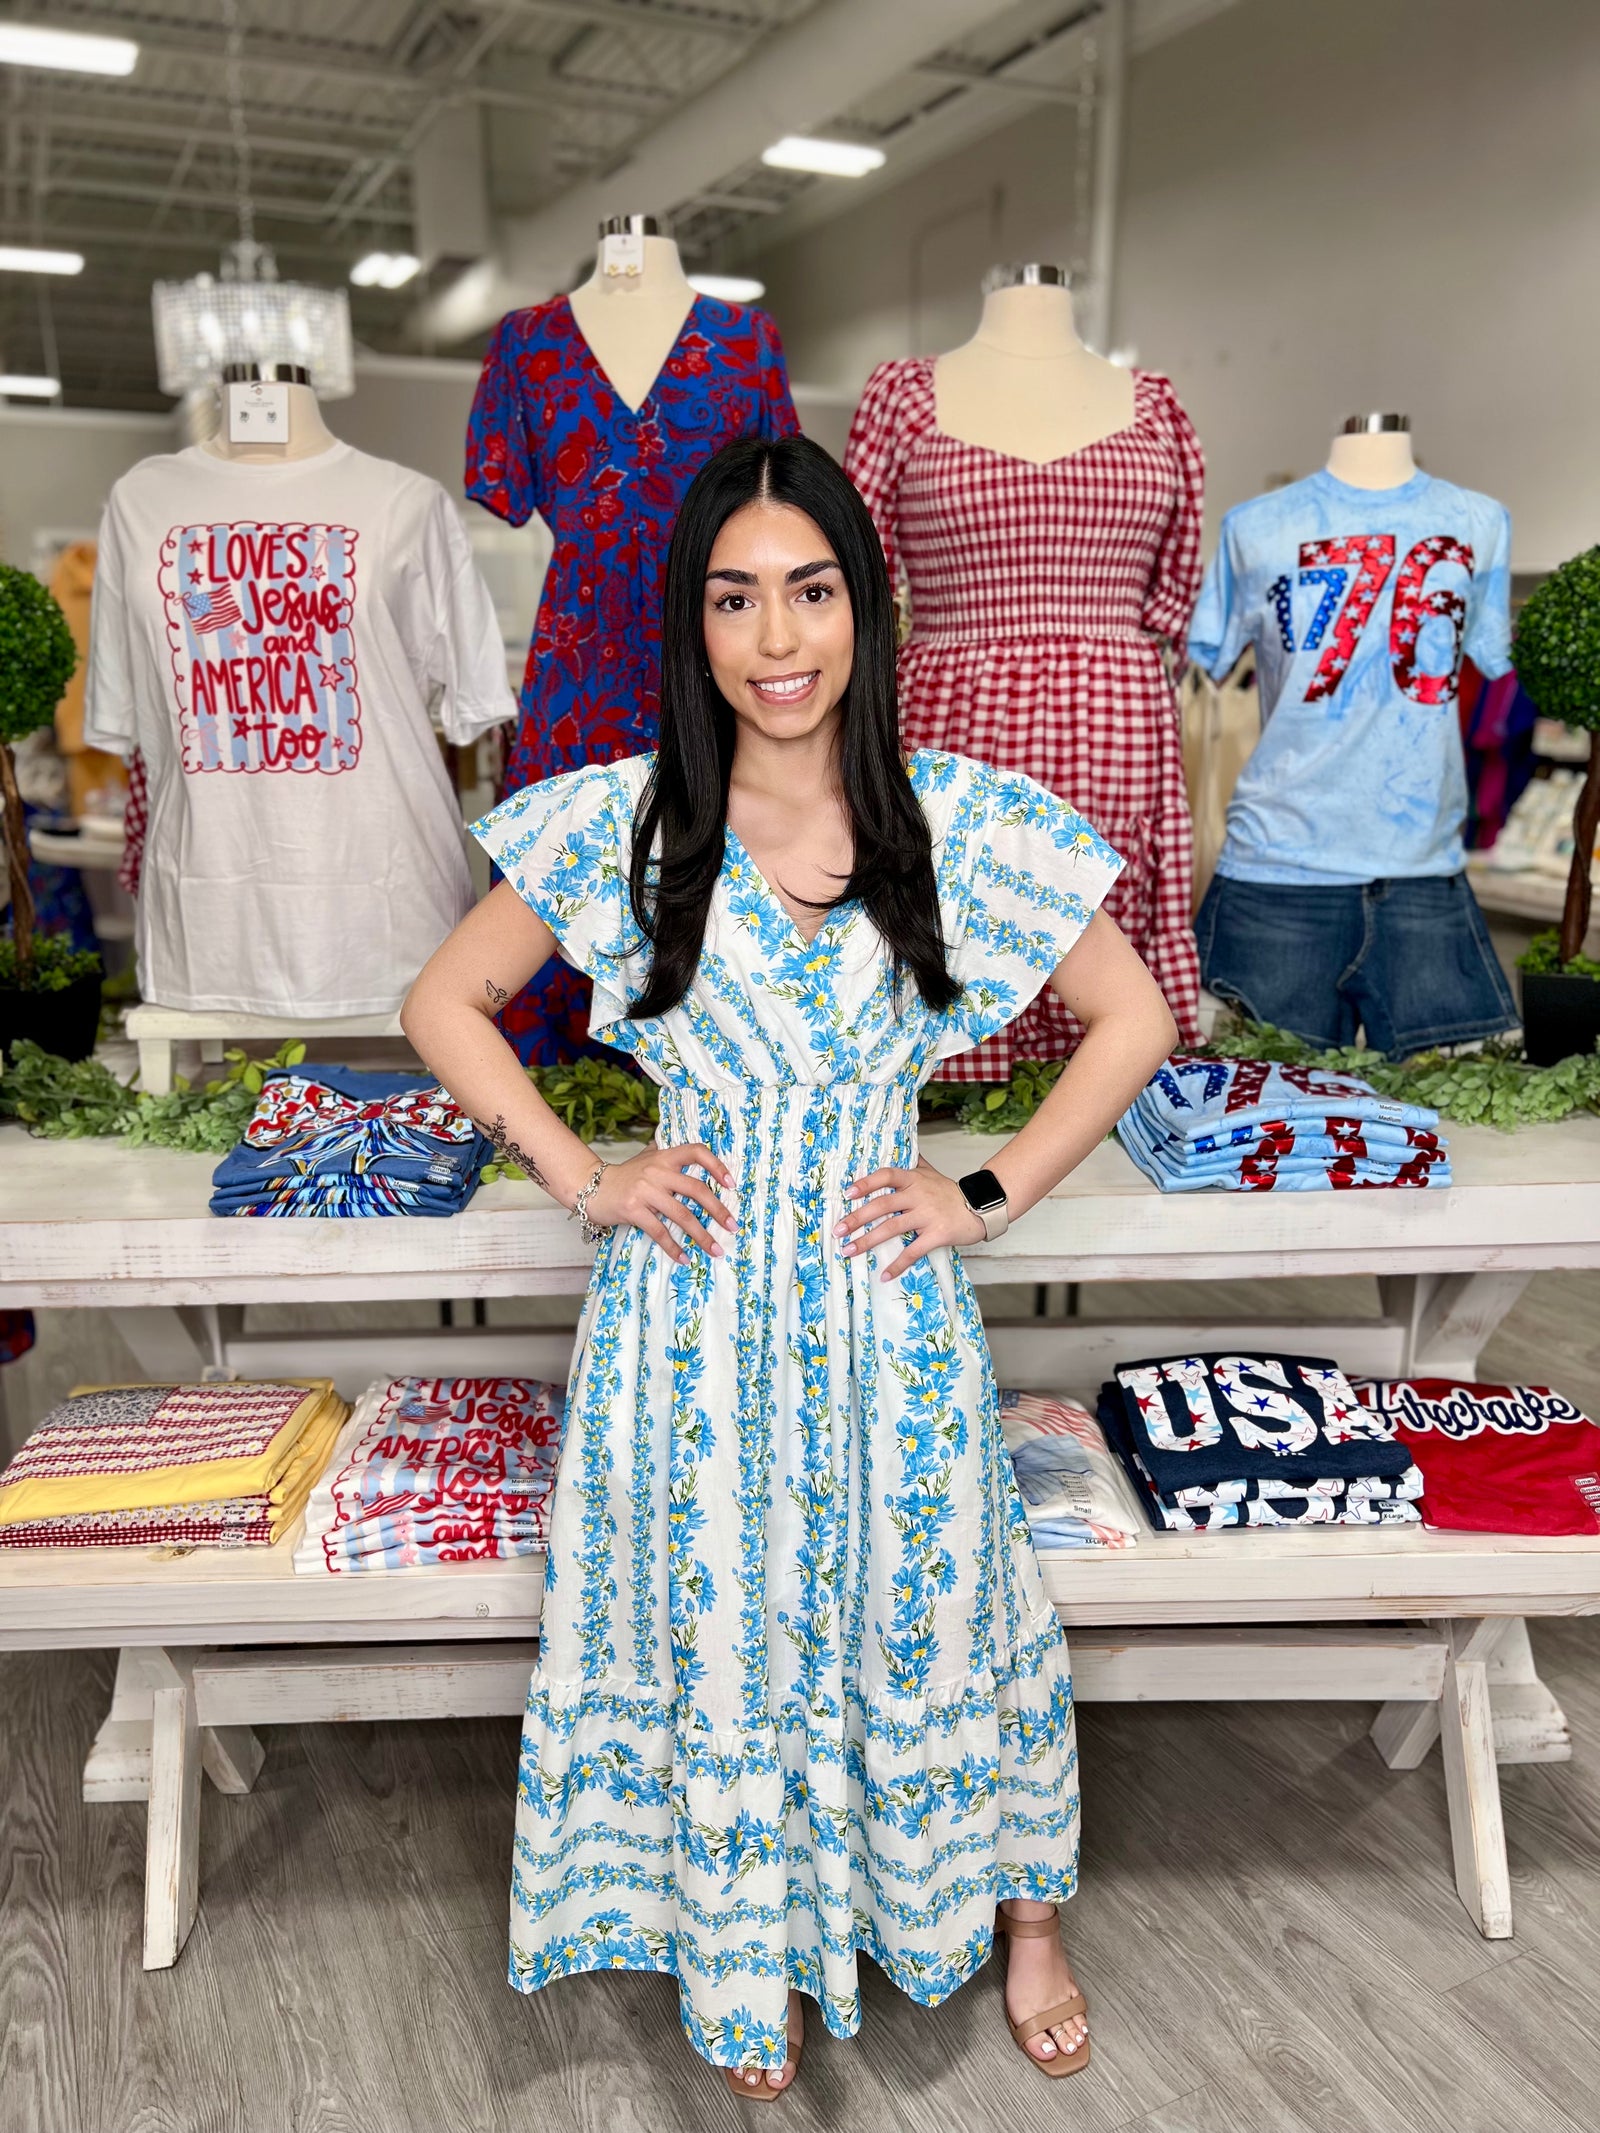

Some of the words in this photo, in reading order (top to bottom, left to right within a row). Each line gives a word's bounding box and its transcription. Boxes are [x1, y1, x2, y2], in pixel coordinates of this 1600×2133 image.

[208, 532, 309, 583] LOVES
[242, 580, 343, 634] Jesus
[1267, 534, 1475, 706] 1776
[263, 621, 322, 656] and
[192, 654, 318, 716] AMERICA
[253, 715, 327, 767] too
[430, 1378, 535, 1405] LOVES
[449, 1398, 557, 1447] Jesus
[464, 1429, 524, 1451] and
[367, 1436, 507, 1478] AMERICA
[1073, 1505, 1092, 1515] Small
[222, 1532, 244, 1540] X-Large
